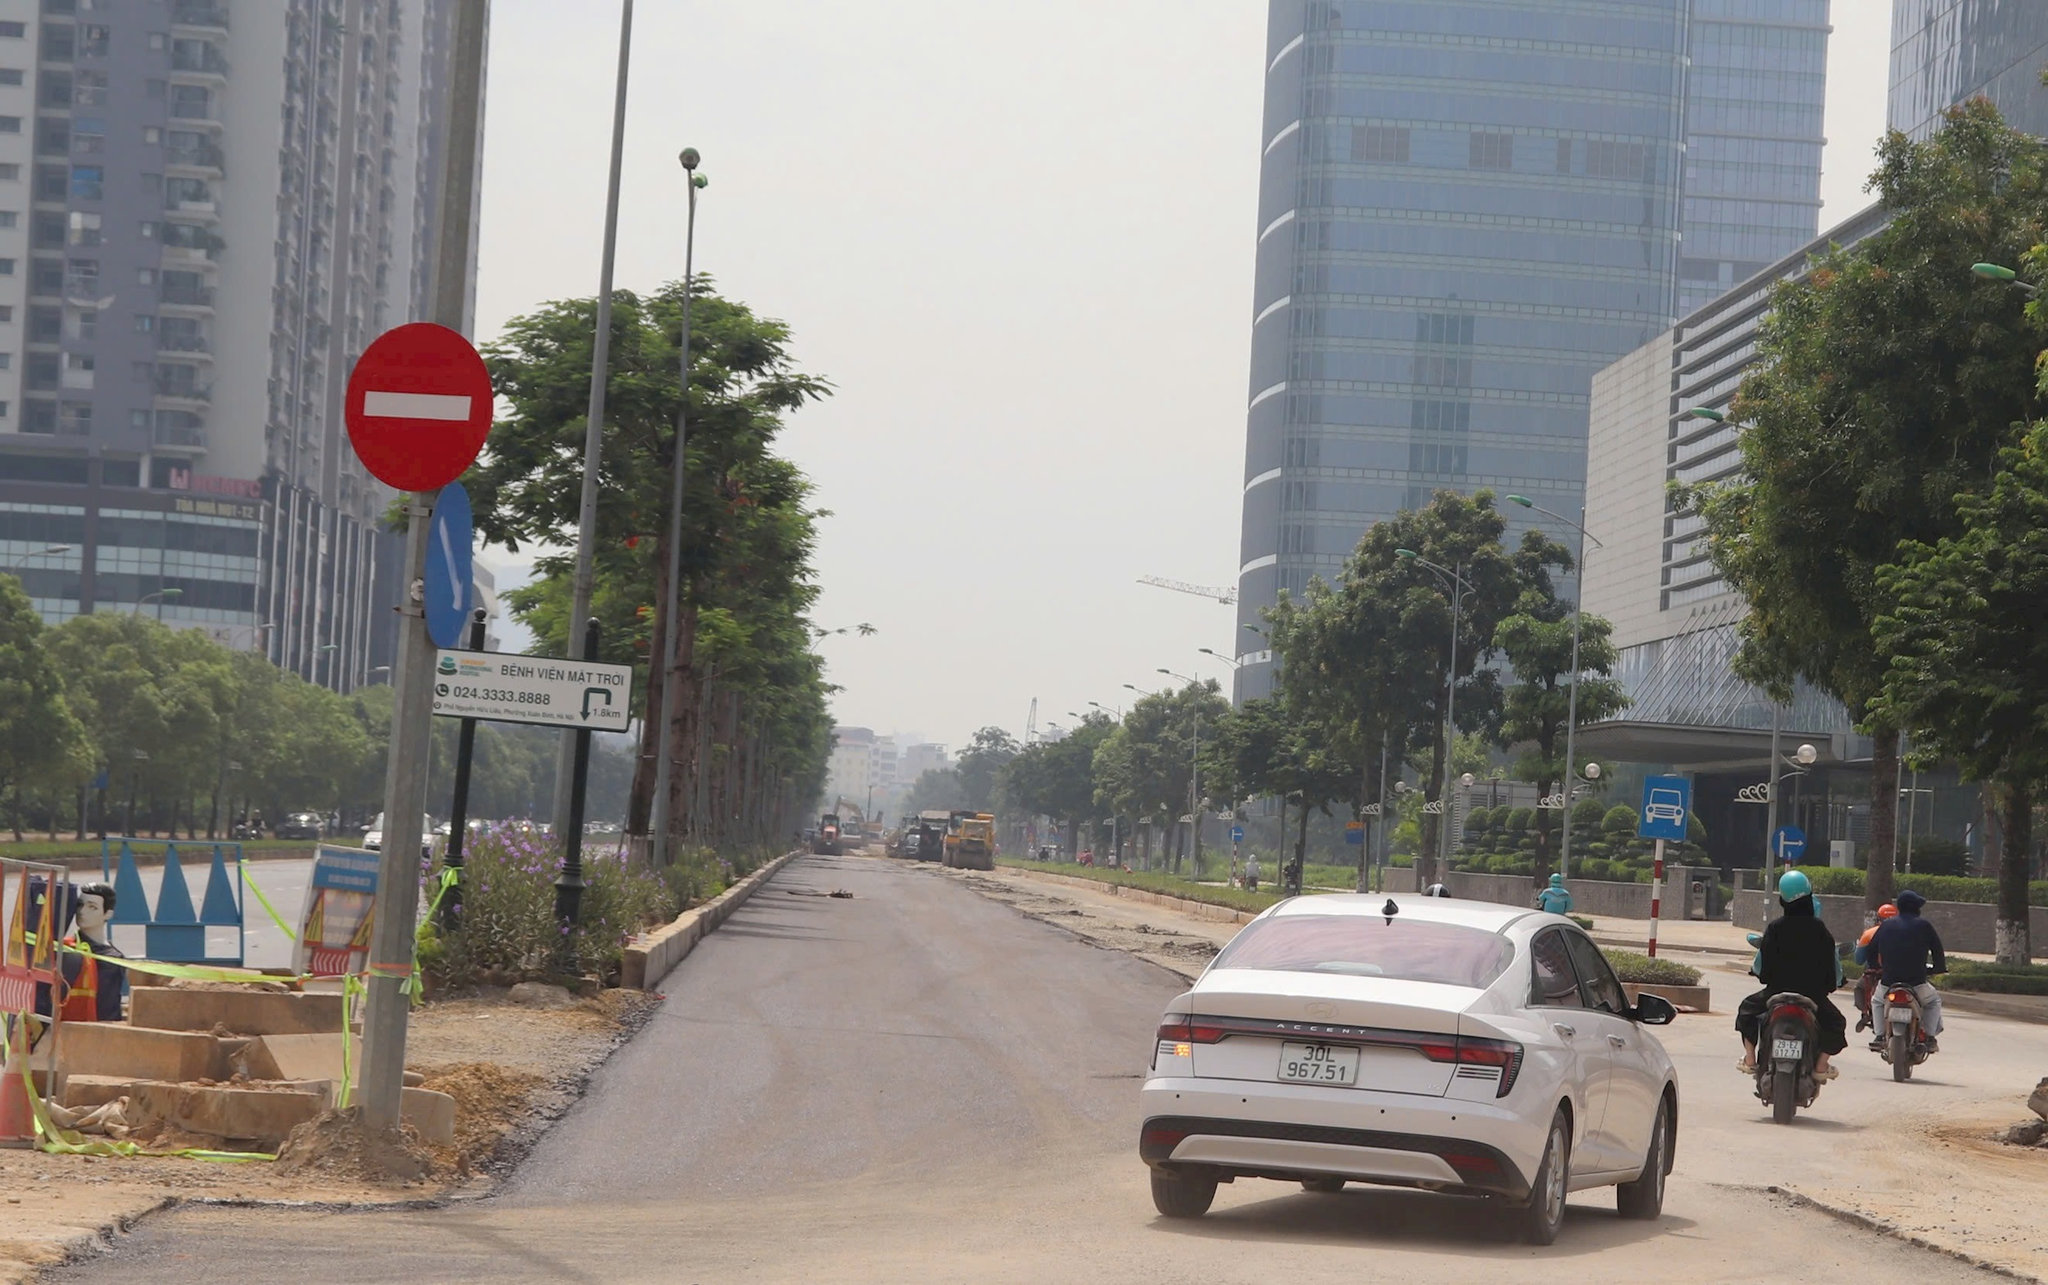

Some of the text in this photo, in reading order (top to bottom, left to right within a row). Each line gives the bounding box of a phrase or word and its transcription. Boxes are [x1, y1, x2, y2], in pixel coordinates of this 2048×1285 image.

[501, 663, 534, 679] BỆNH
[537, 666, 565, 682] VIỆN
[453, 686, 551, 705] 024.3333.8888
[1277, 1023, 1366, 1034] ACCENT
[1303, 1046, 1335, 1063] 30L
[1287, 1062, 1346, 1081] 967.51
